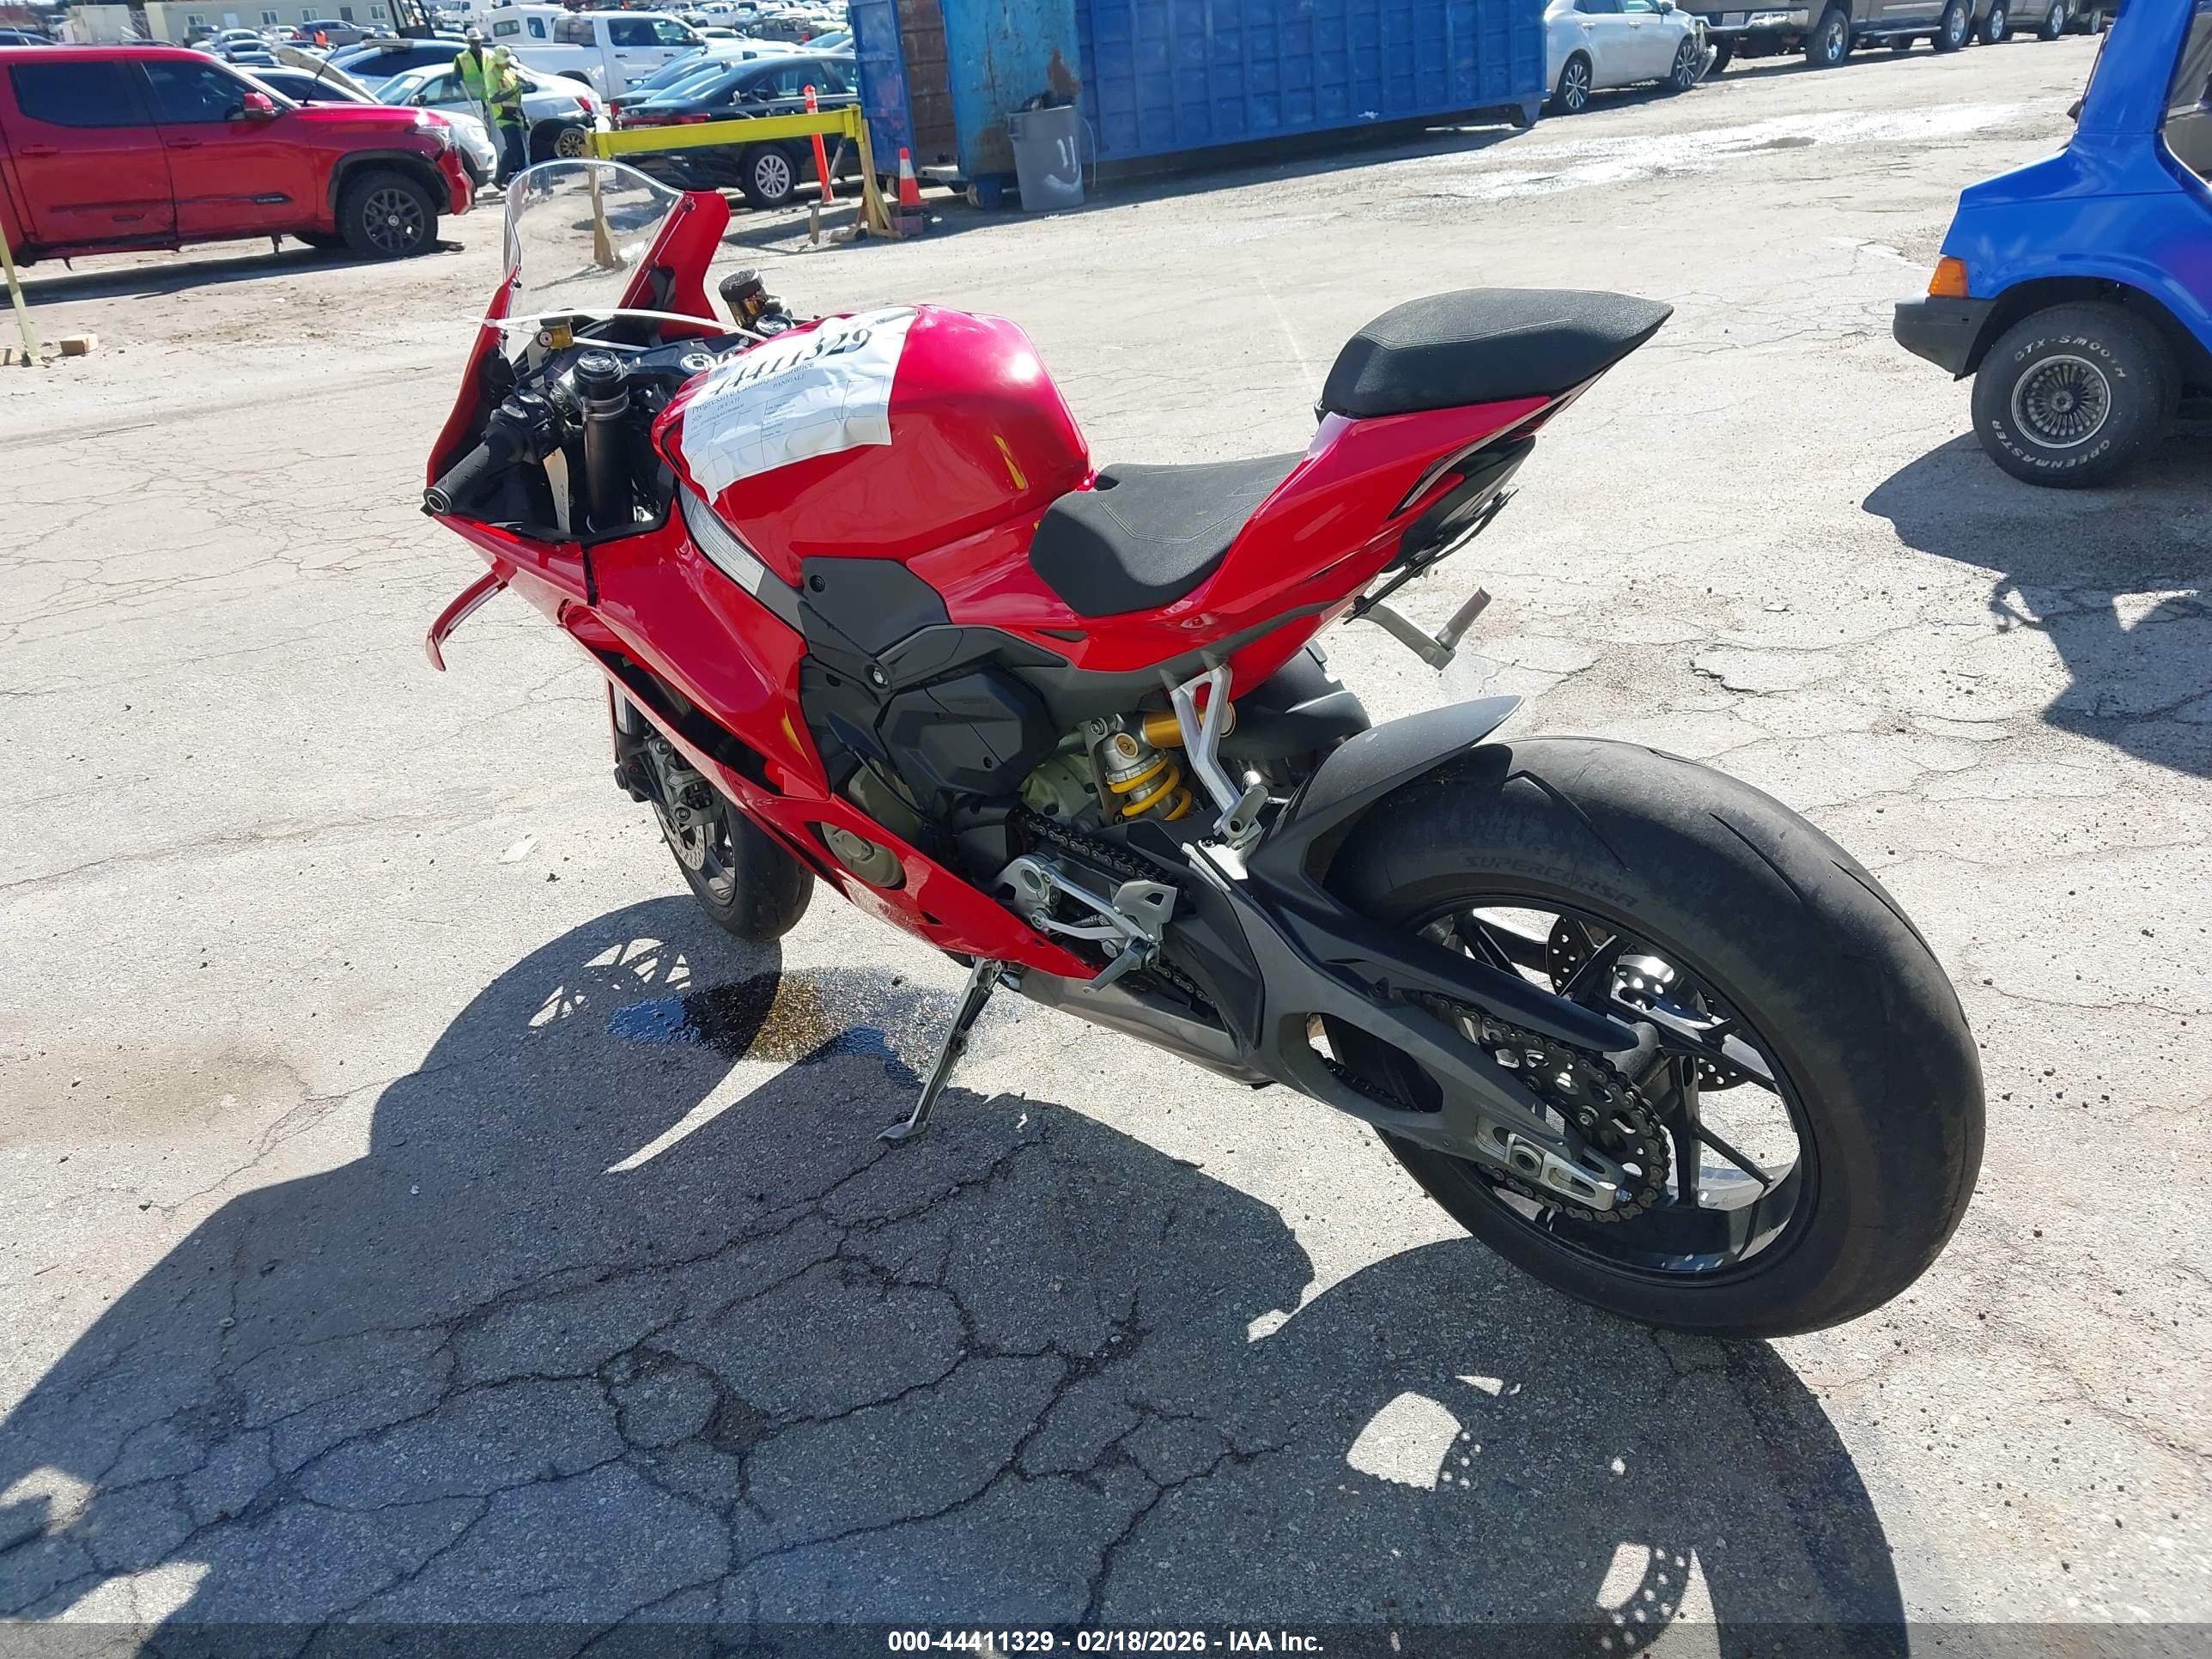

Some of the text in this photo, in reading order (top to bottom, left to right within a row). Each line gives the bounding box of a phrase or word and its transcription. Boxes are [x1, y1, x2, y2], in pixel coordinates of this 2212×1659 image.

[692, 362, 815, 414] Progressive Casualty Insurance
[1991, 420, 2111, 469] GREENMASTER
[1465, 855, 1640, 908] SUPERCORSA
